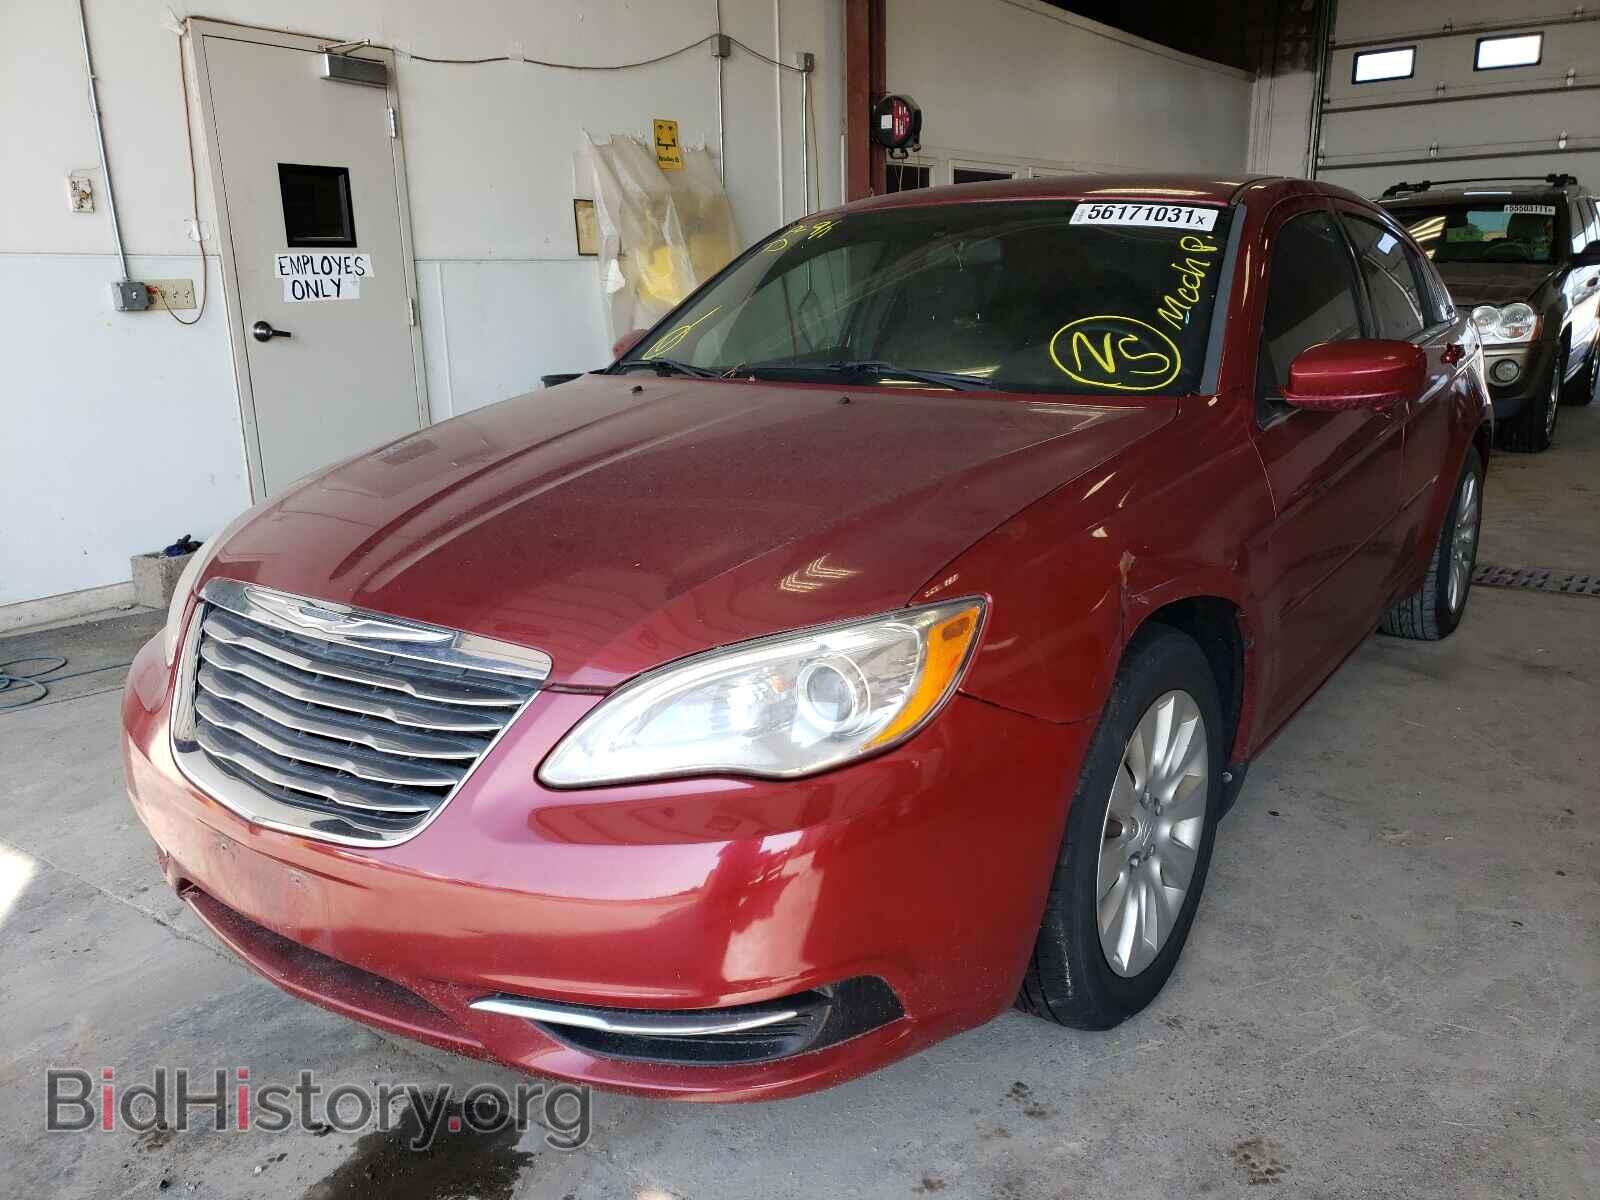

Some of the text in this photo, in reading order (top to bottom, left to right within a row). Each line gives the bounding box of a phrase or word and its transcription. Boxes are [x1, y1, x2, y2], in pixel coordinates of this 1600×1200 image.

[1087, 205, 1195, 224] 56171031
[278, 254, 365, 276] EMPLOYES
[291, 278, 341, 301] ONLY
